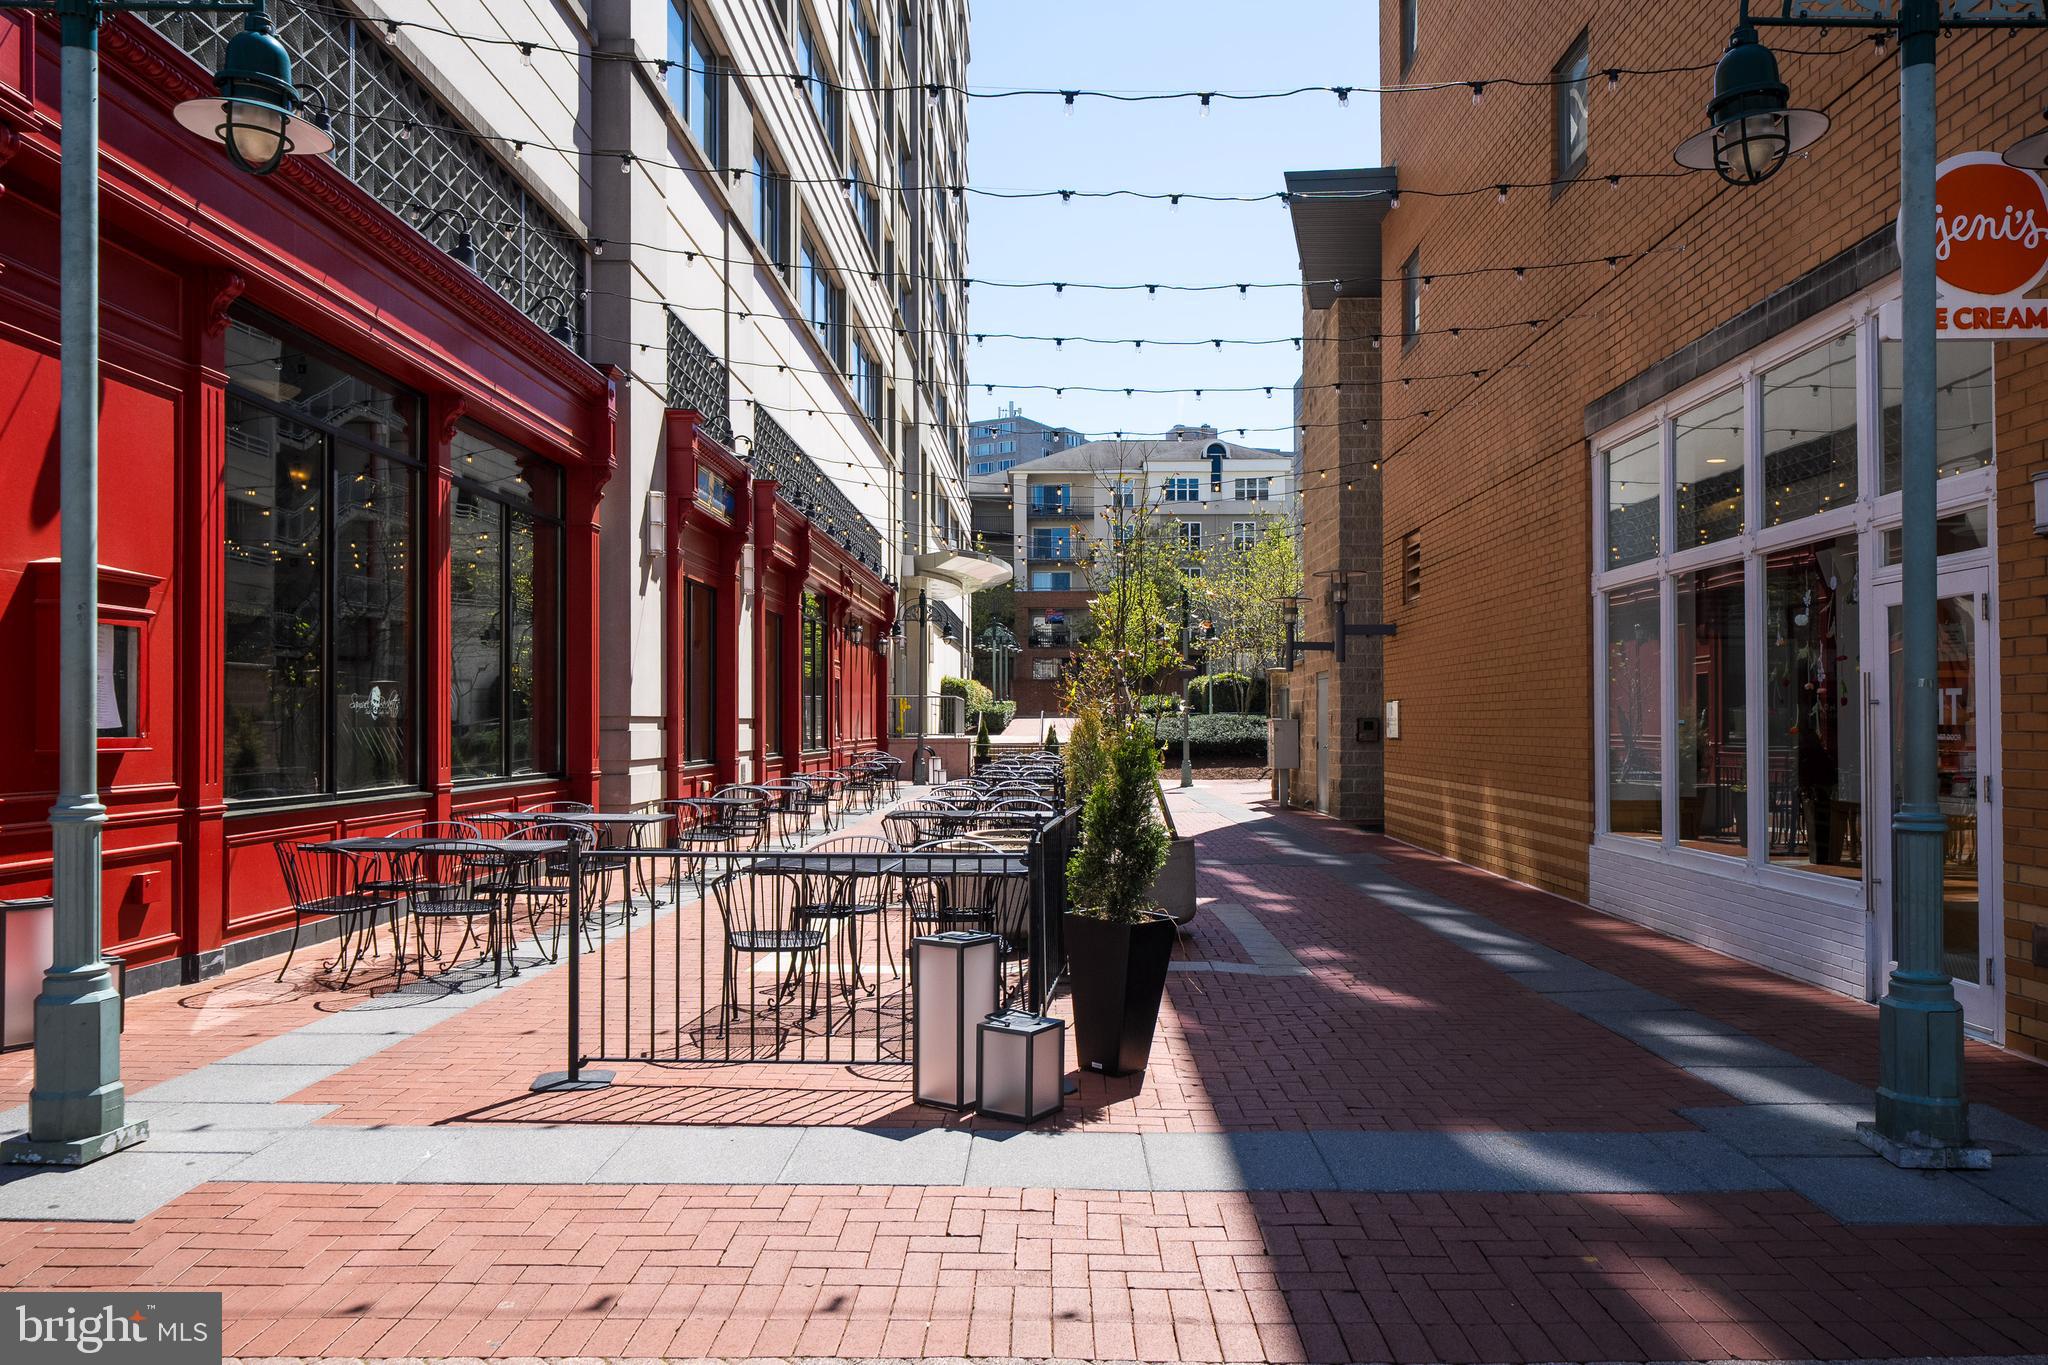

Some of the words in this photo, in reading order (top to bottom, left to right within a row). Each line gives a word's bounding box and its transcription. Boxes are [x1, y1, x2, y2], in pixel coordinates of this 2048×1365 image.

[1936, 204, 2048, 261] jeni's
[1953, 306, 2048, 330] CREAM
[1938, 687, 1963, 726] IT
